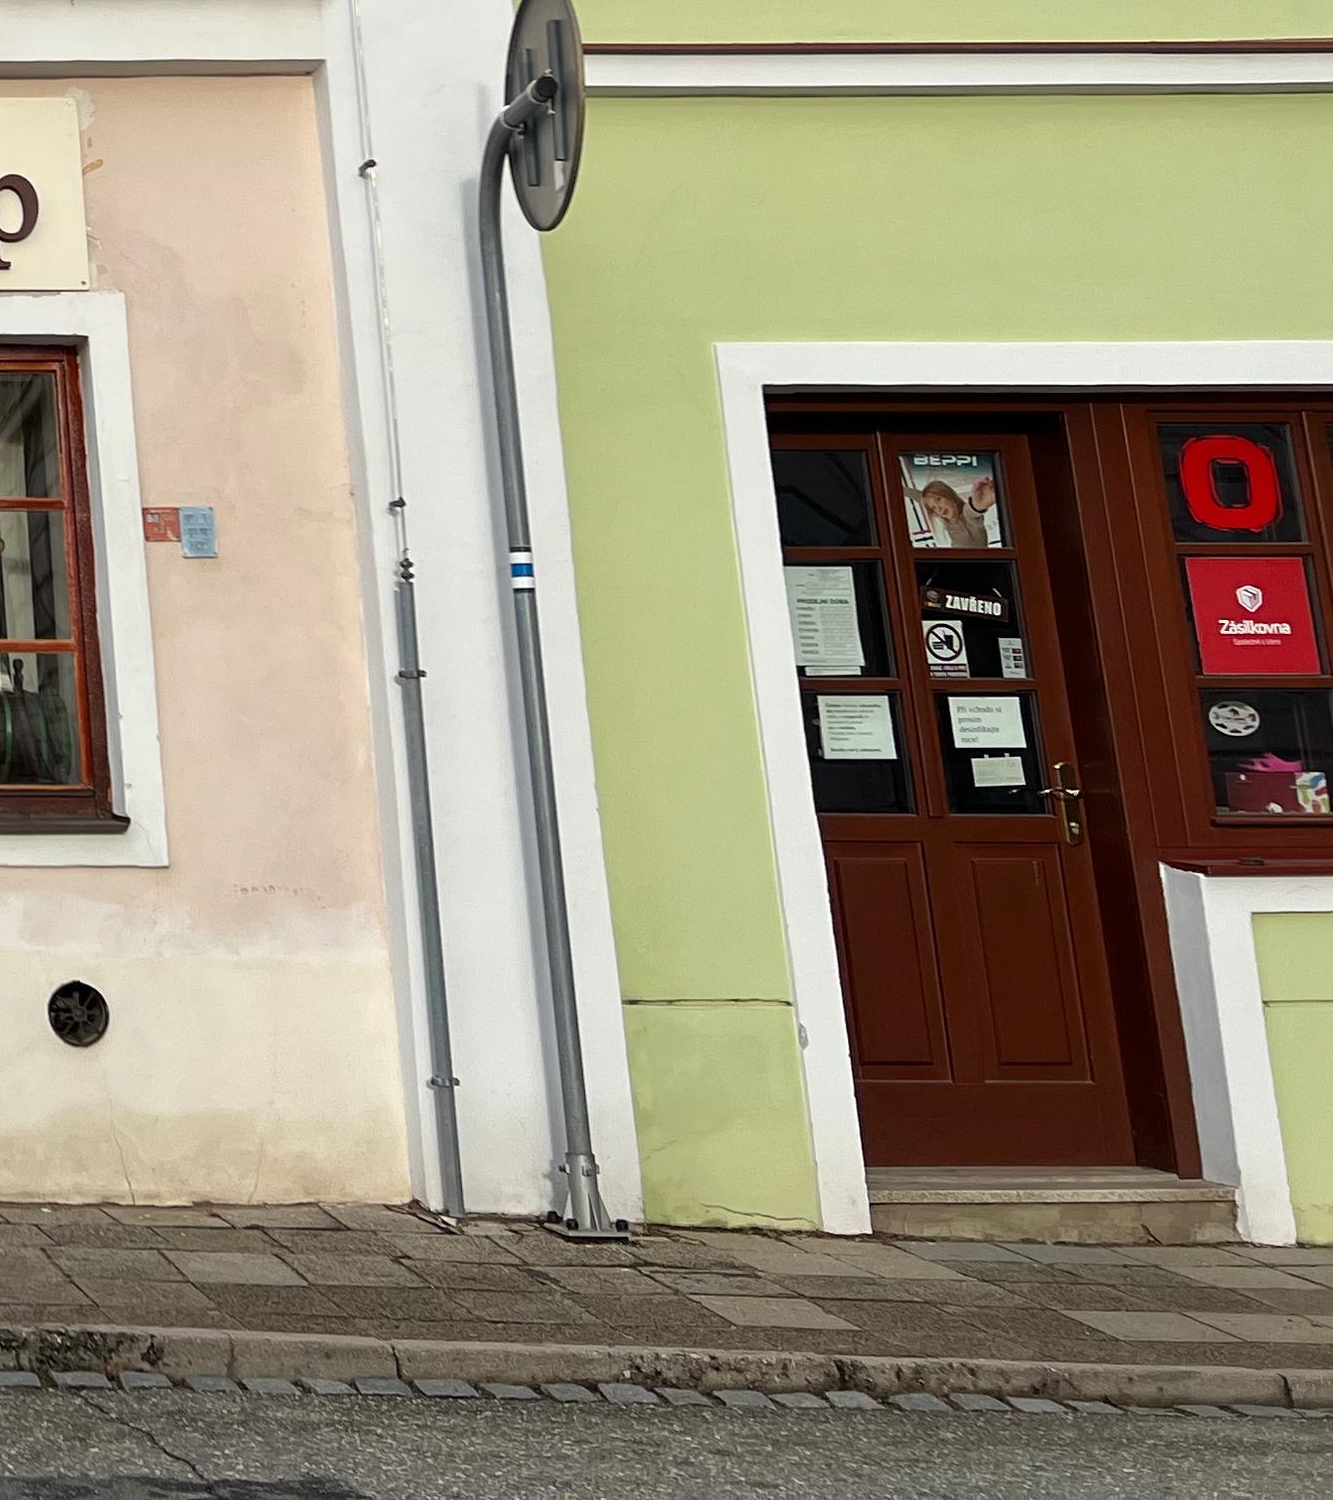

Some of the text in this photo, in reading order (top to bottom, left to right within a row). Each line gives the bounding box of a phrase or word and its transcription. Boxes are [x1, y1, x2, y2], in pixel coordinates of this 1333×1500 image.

[913, 455, 978, 467] BEPPI
[945, 594, 1002, 616] ZAVŘENO
[1218, 620, 1292, 634] Zásilkovna
